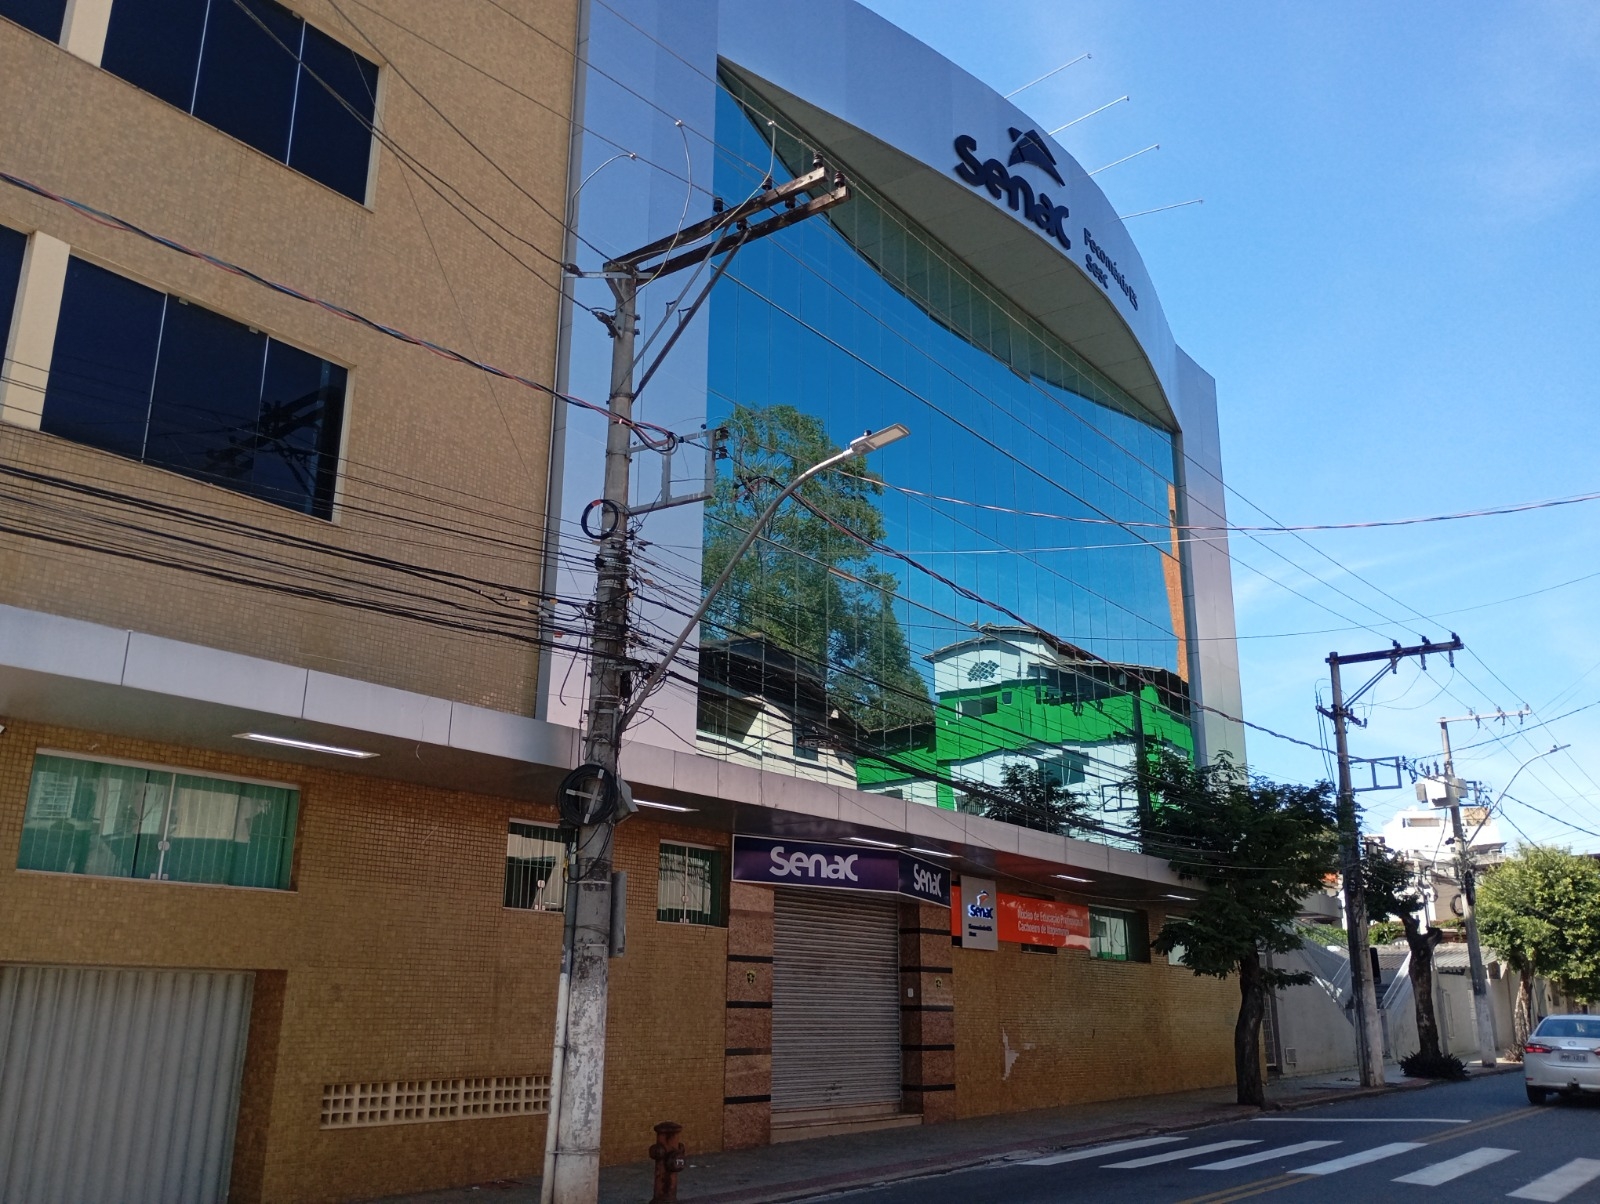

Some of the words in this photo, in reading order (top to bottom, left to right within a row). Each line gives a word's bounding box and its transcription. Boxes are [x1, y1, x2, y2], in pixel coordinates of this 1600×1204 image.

[768, 845, 859, 883] Senac
[912, 863, 942, 898] Senac
[1034, 911, 1040, 921] de
[1041, 924, 1047, 934] de
